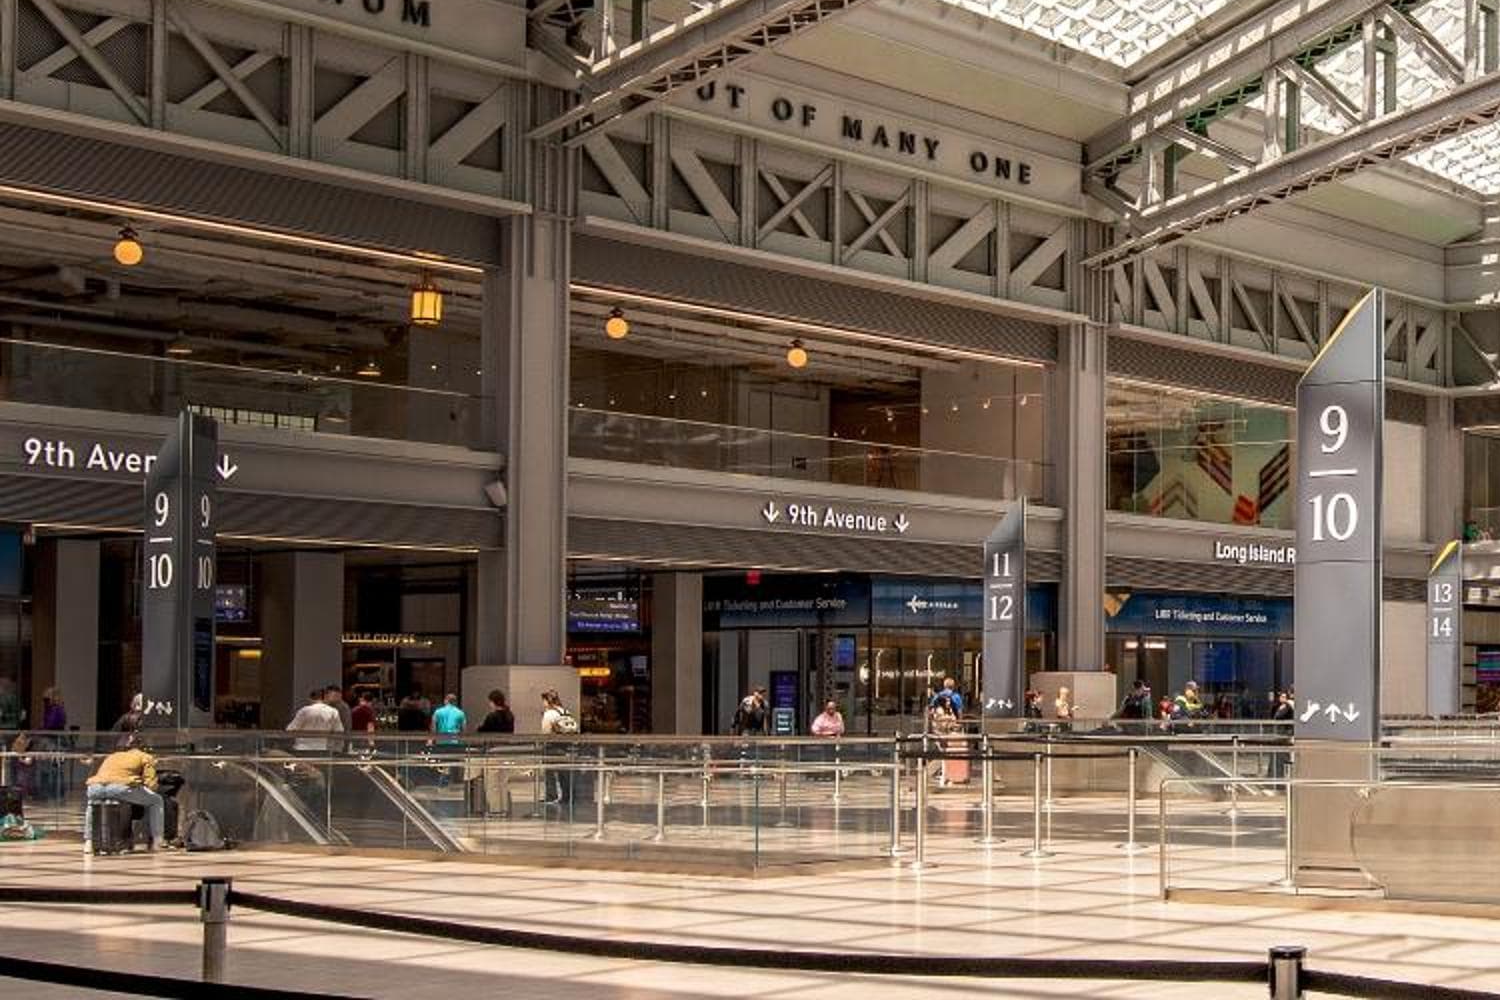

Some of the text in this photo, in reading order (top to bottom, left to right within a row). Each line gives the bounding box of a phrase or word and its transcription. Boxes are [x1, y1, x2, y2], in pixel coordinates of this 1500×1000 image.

[771, 97, 817, 127] OF
[841, 115, 940, 161] MANY
[969, 151, 1032, 186] ONE
[1319, 405, 1348, 454] 9
[24, 438, 75, 467] 9th
[154, 492, 169, 528] 9
[201, 494, 211, 528] 9
[788, 504, 887, 532] 9th Avenue
[1309, 493, 1358, 541] 10
[992, 552, 1011, 577] 11
[1215, 541, 1247, 564] Long
[1249, 544, 1285, 564] Island
[149, 554, 173, 590] 10
[198, 556, 213, 590] 10
[991, 595, 1013, 620] 12
[1433, 583, 1452, 603] 13
[1432, 617, 1453, 637] 14
